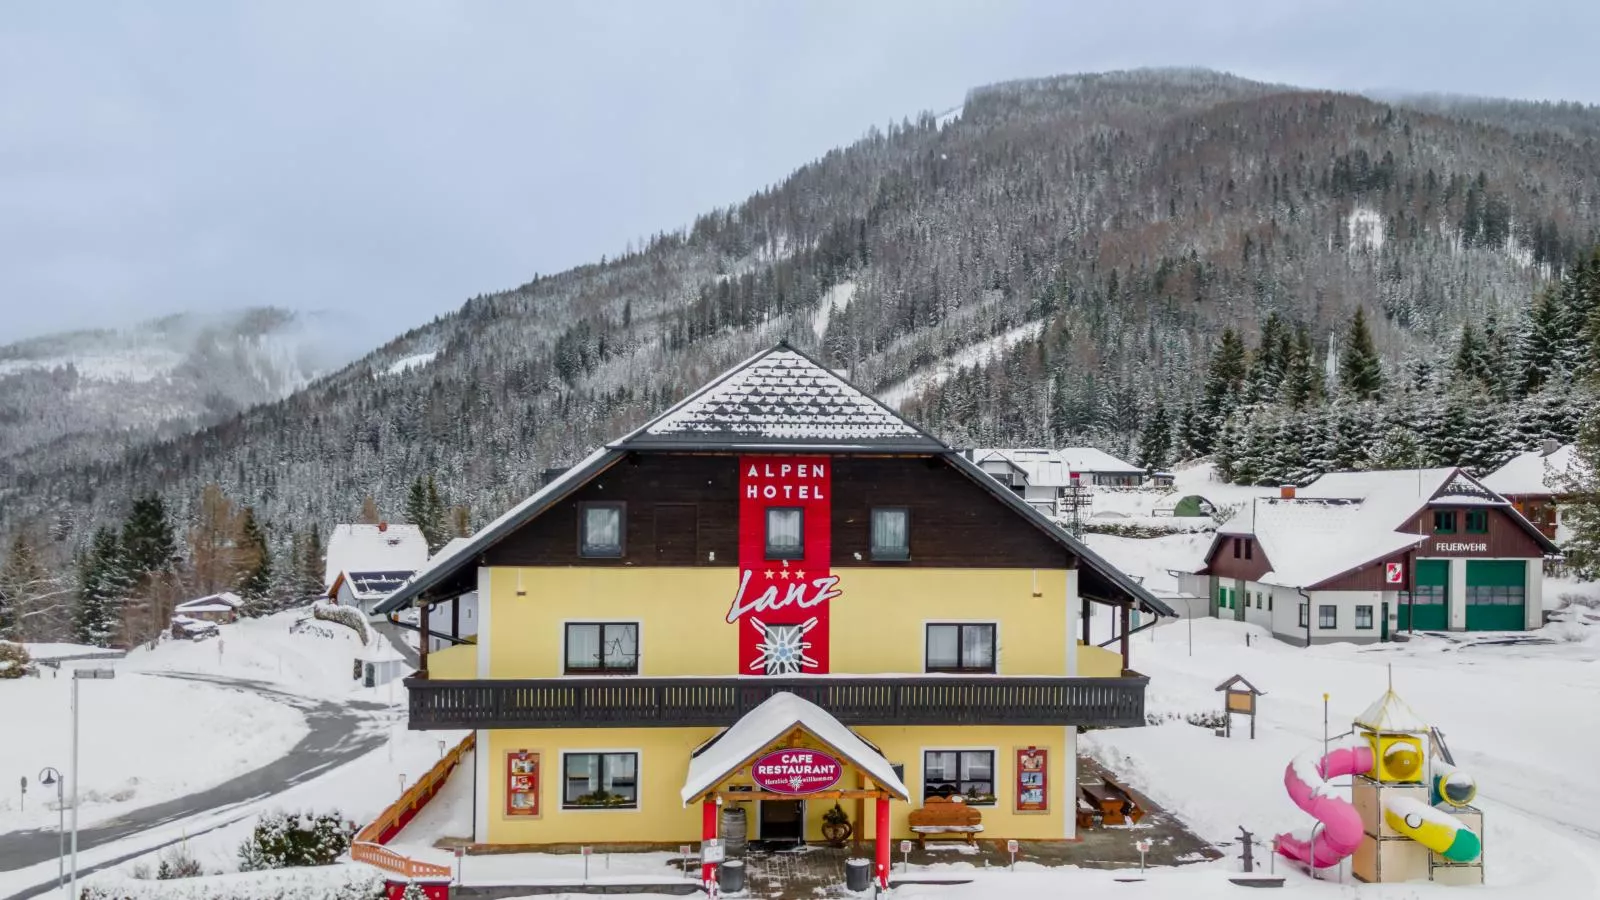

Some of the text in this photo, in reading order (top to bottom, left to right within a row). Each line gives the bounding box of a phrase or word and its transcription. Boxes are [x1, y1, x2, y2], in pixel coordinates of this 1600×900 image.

[748, 464, 824, 477] ALPEN
[747, 485, 824, 499] HOTEL
[1436, 542, 1487, 551] FEUERWEHR
[726, 569, 842, 624] Lanz
[782, 755, 813, 763] CAFE
[759, 765, 835, 774] RESTAURANT
